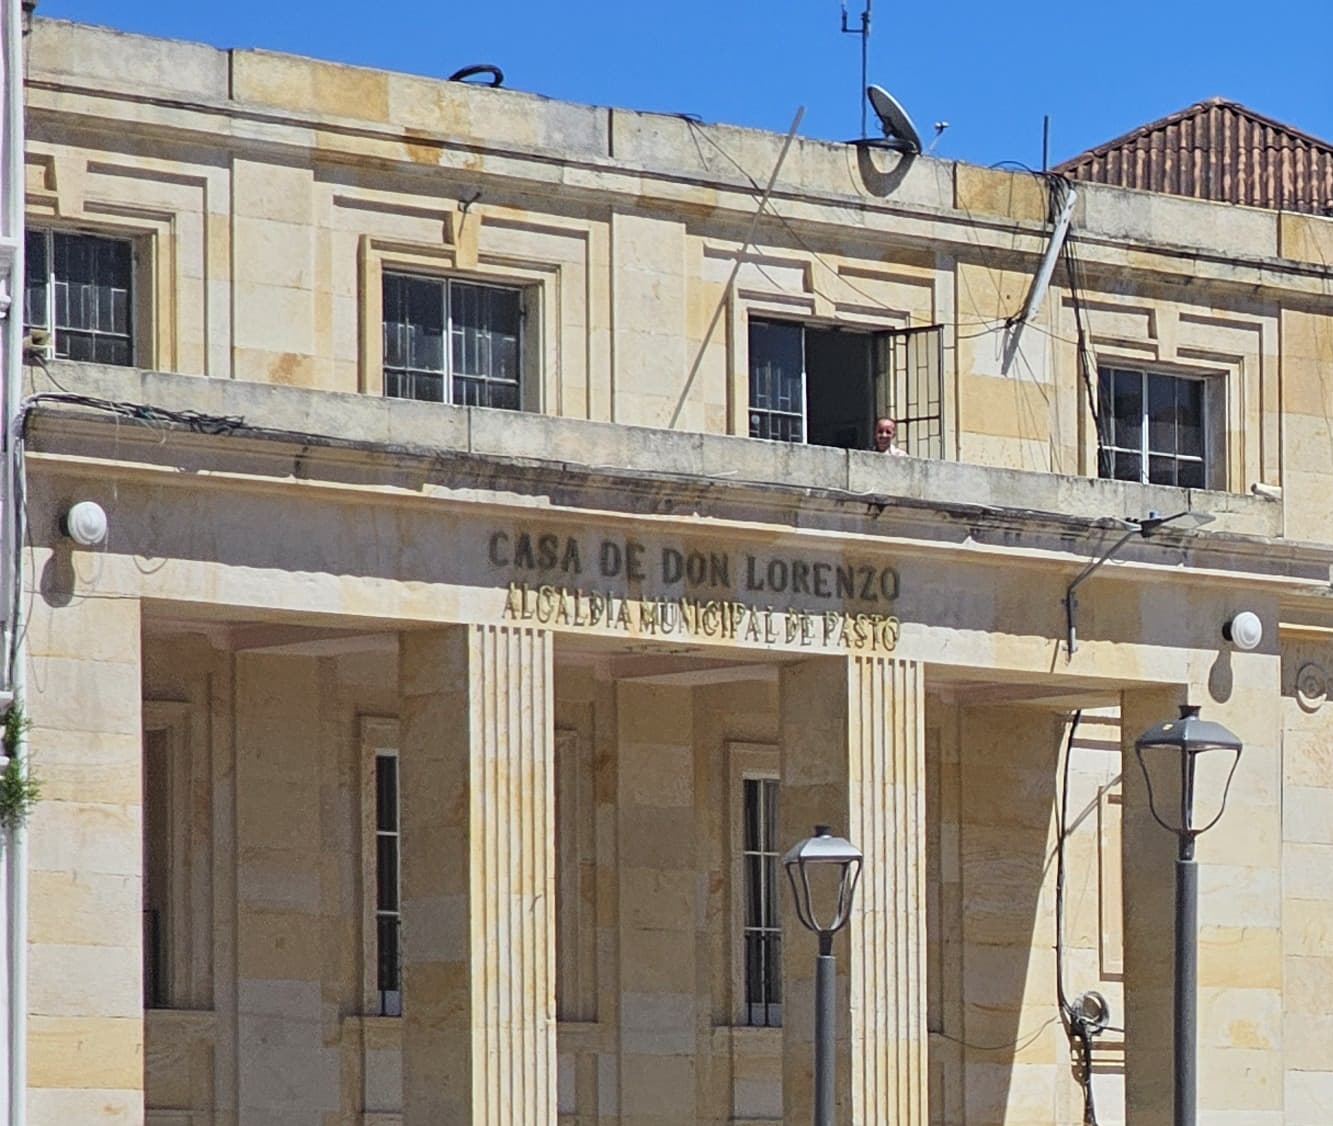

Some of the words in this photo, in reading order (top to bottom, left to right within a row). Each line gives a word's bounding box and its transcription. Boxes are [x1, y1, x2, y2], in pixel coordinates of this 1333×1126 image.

[487, 530, 582, 574] CASA
[600, 541, 646, 582] DE
[662, 547, 731, 589] DON
[746, 555, 900, 602] LORENZO
[639, 595, 775, 645] MUNICIPAL
[786, 607, 814, 648] DE
[822, 610, 900, 653] PASTO
